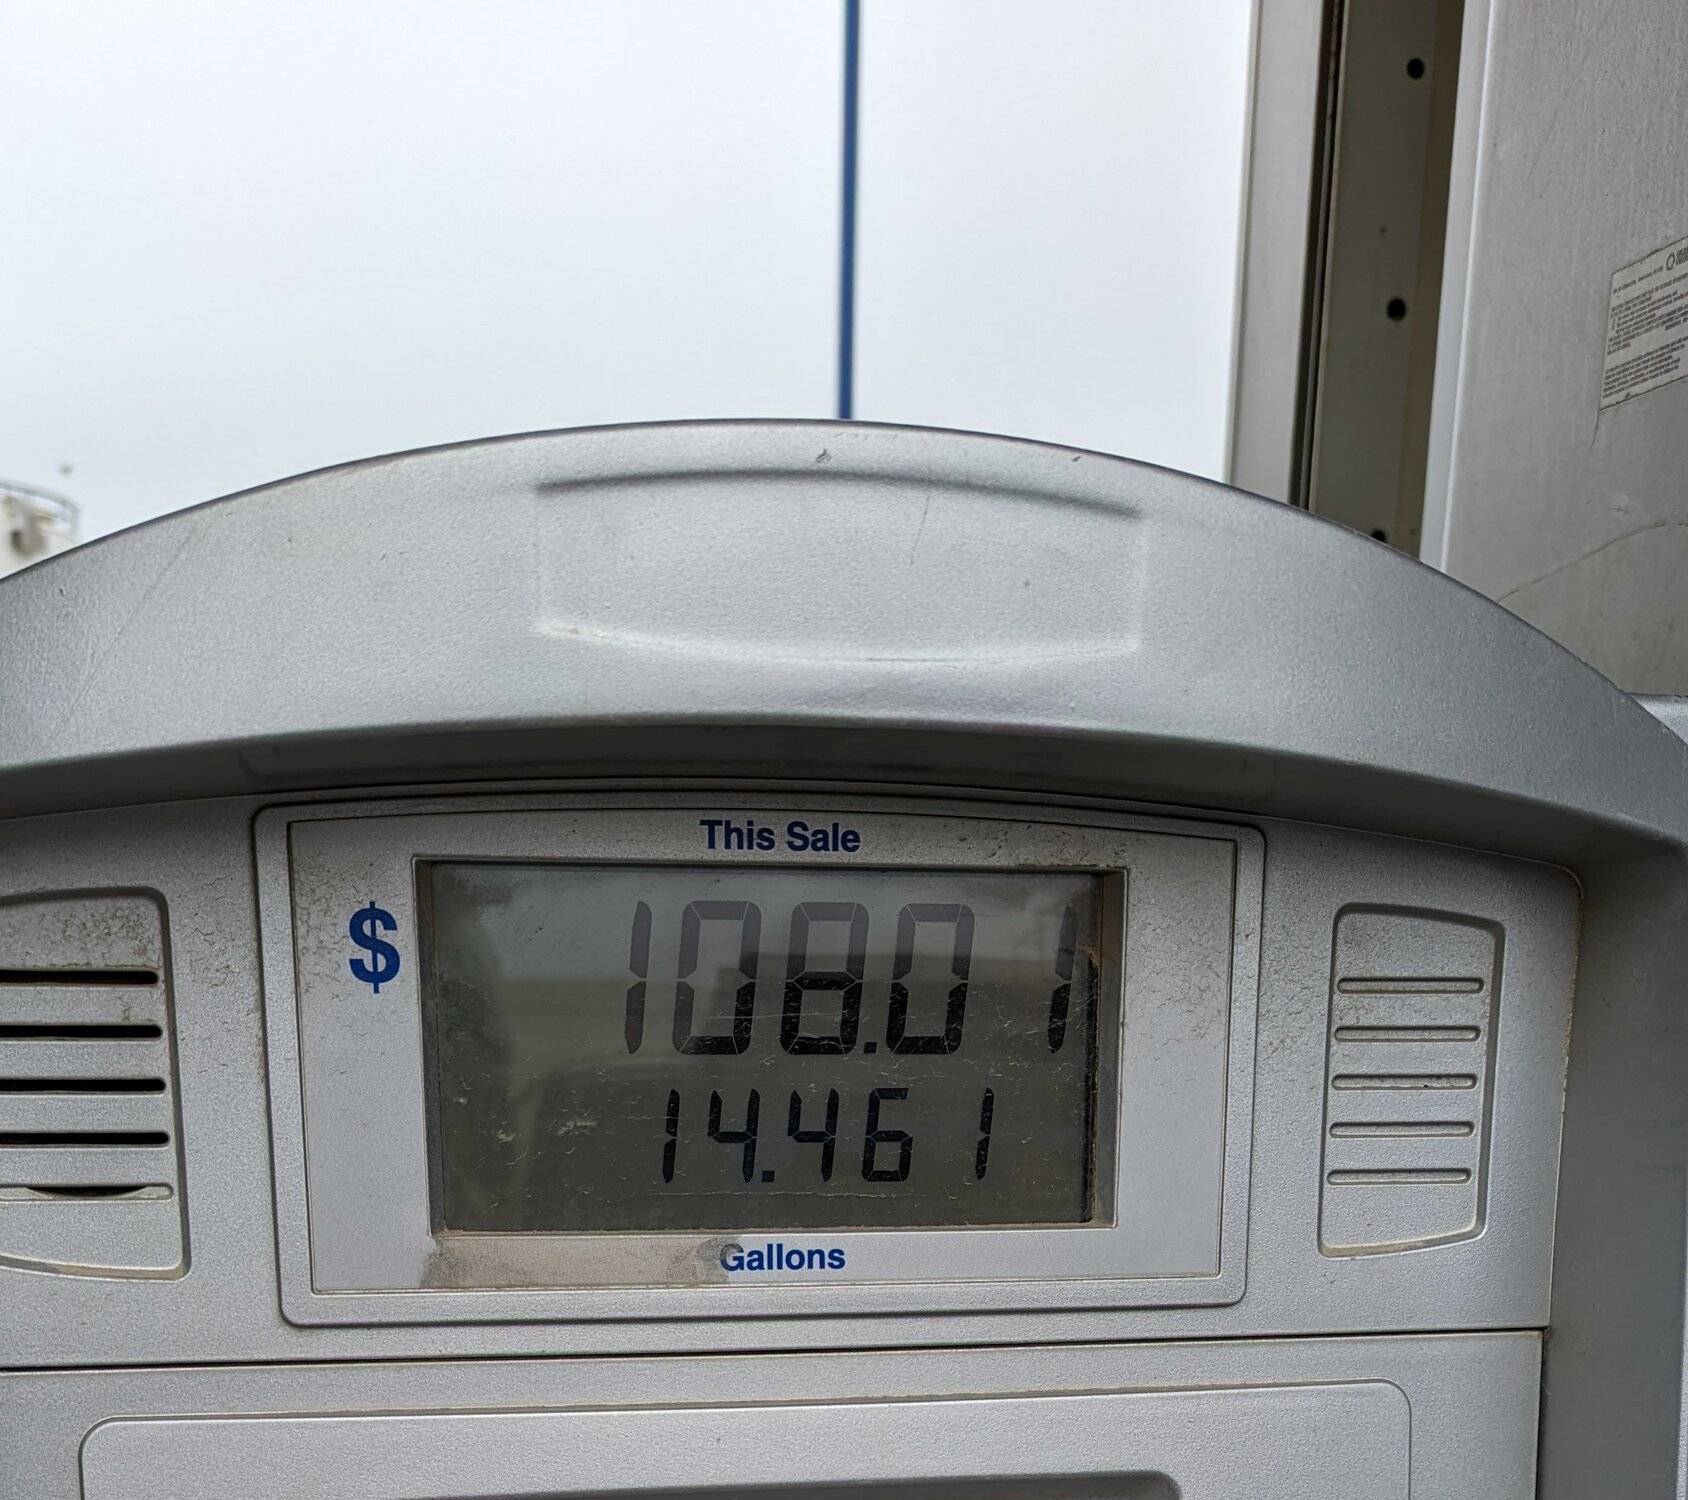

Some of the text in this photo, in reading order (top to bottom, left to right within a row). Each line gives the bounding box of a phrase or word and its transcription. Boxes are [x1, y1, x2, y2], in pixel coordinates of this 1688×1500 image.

[699, 820, 861, 852] This Sale
[348, 900, 400, 993] $
[623, 900, 1077, 1055] 108.01
[662, 1087, 994, 1184] 14.461
[720, 1243, 846, 1271] Gallons
